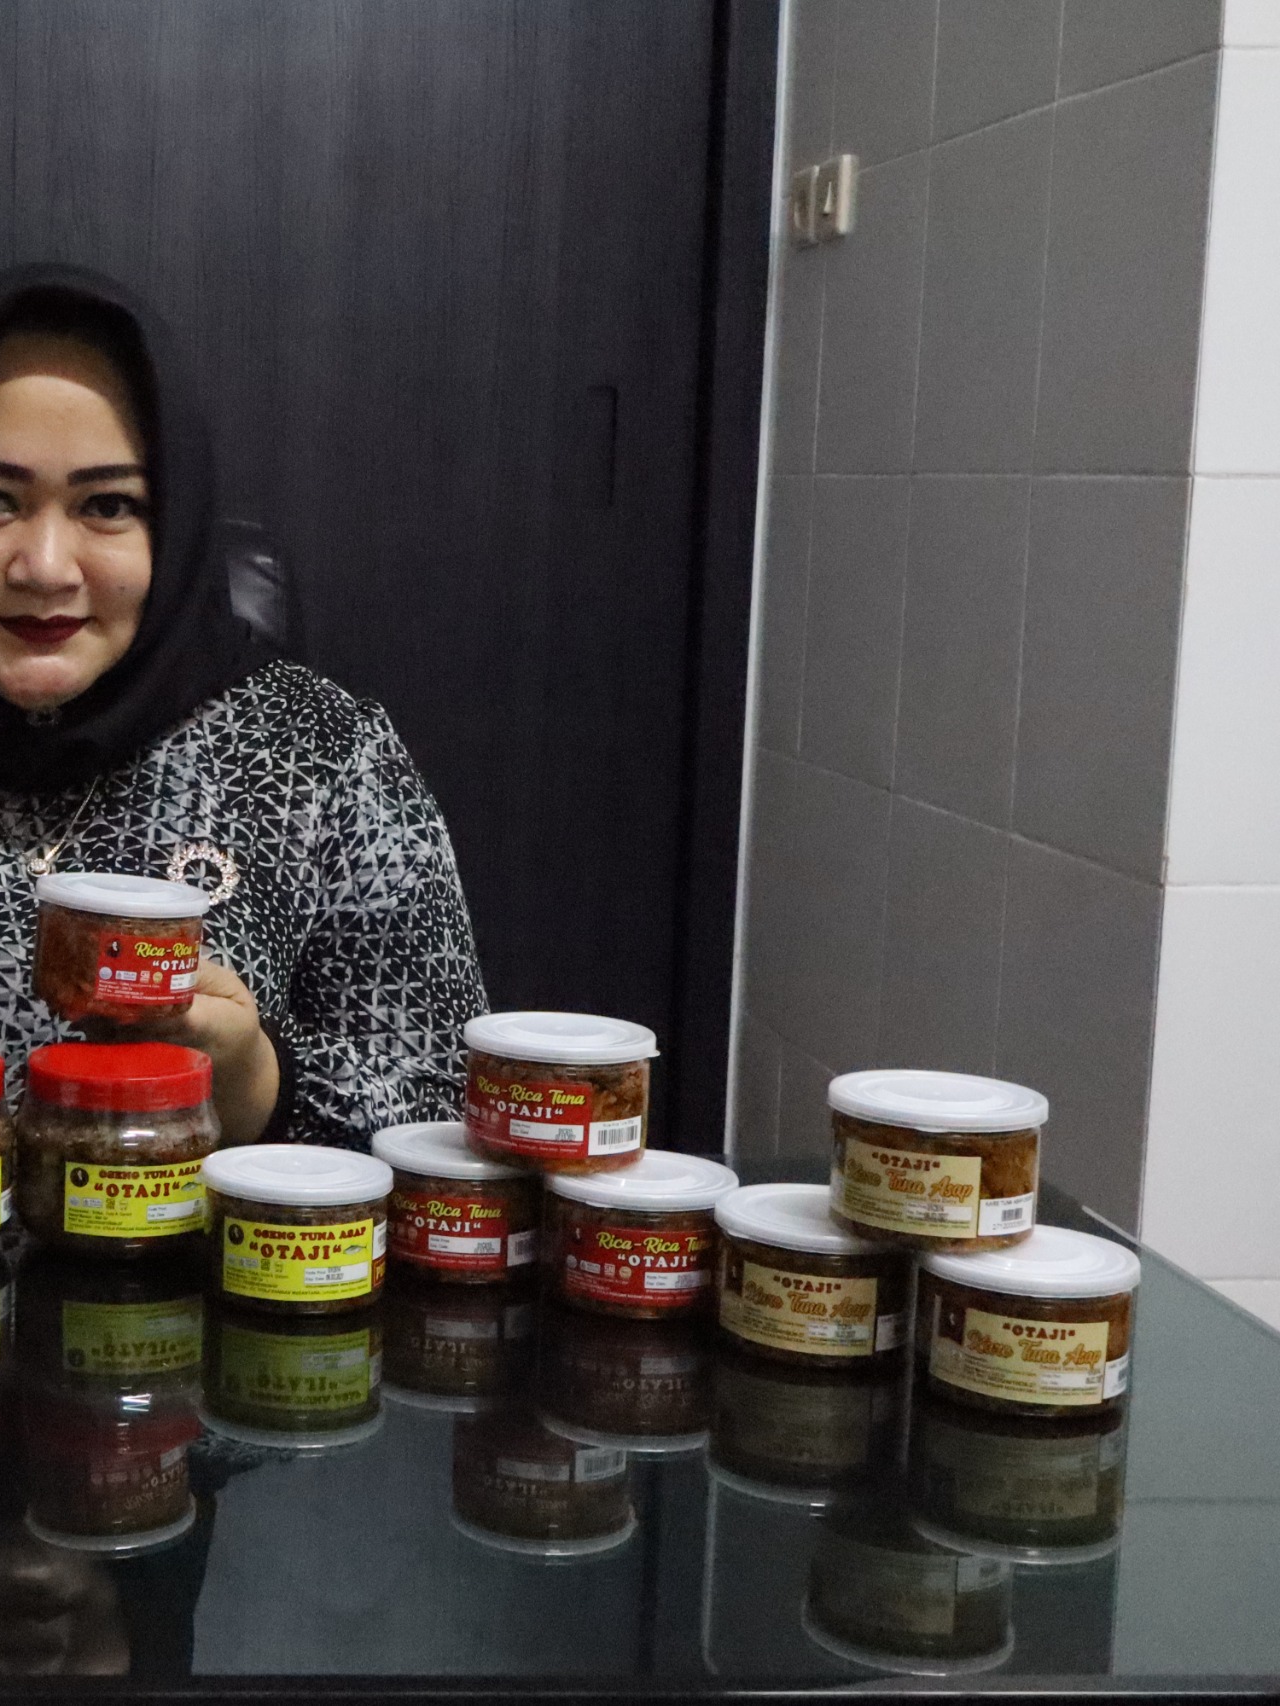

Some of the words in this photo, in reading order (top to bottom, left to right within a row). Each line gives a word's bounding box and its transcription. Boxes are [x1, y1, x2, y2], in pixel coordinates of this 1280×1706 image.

[548, 1089, 586, 1106] Tuna
[143, 1169, 175, 1180] TUNA
[885, 1168, 926, 1195] Tuna
[928, 1175, 974, 1204] Asap
[467, 1203, 502, 1220] Tuna
[253, 1227, 296, 1241] OSENG
[299, 1231, 336, 1241] TUNA
[339, 1226, 367, 1240] ASAP
[787, 1291, 827, 1316] Tuna
[830, 1296, 872, 1323] Asap
[1018, 1339, 1061, 1365] Tuna
[1062, 1343, 1102, 1370] Asap
